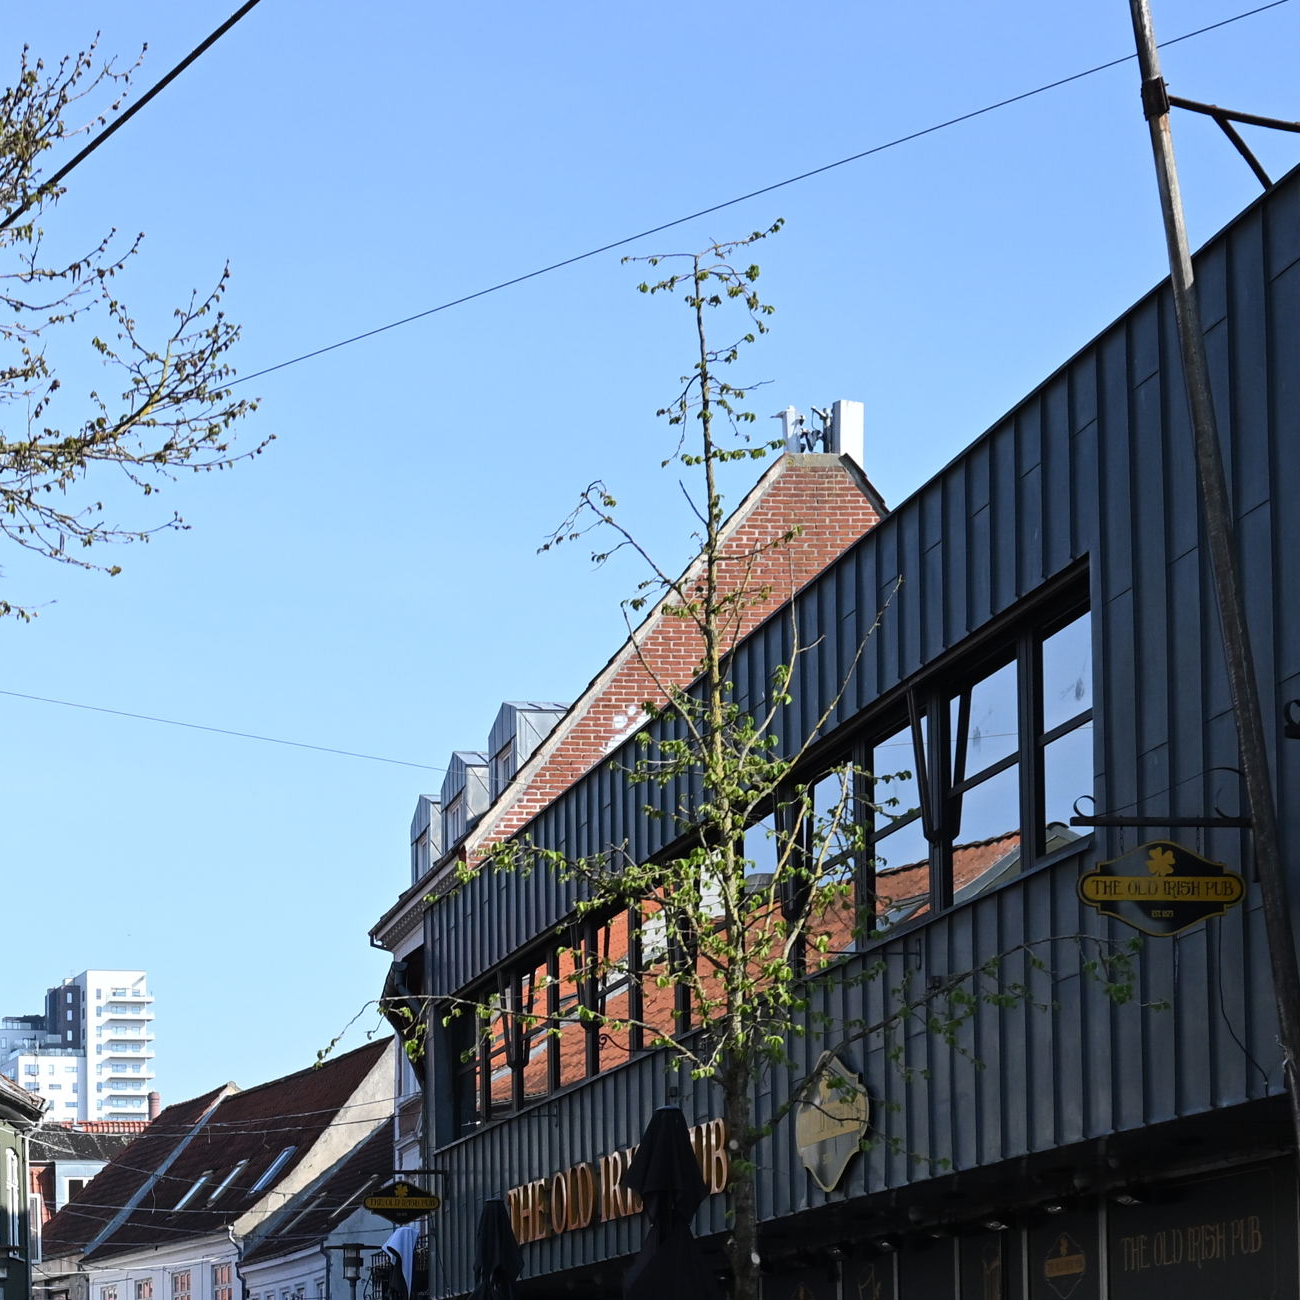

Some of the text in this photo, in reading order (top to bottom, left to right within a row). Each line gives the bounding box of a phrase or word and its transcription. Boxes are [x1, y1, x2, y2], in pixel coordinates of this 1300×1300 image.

[1092, 880, 1236, 898] THE OLD IRISH PUB
[507, 1178, 547, 1245] THE
[551, 1162, 593, 1235] OLD
[689, 1117, 729, 1194] UB
[1121, 1235, 1149, 1272] THE
[1154, 1229, 1183, 1266] OLD
[1188, 1222, 1226, 1269] IRISH
[1231, 1216, 1262, 1255] PUB
